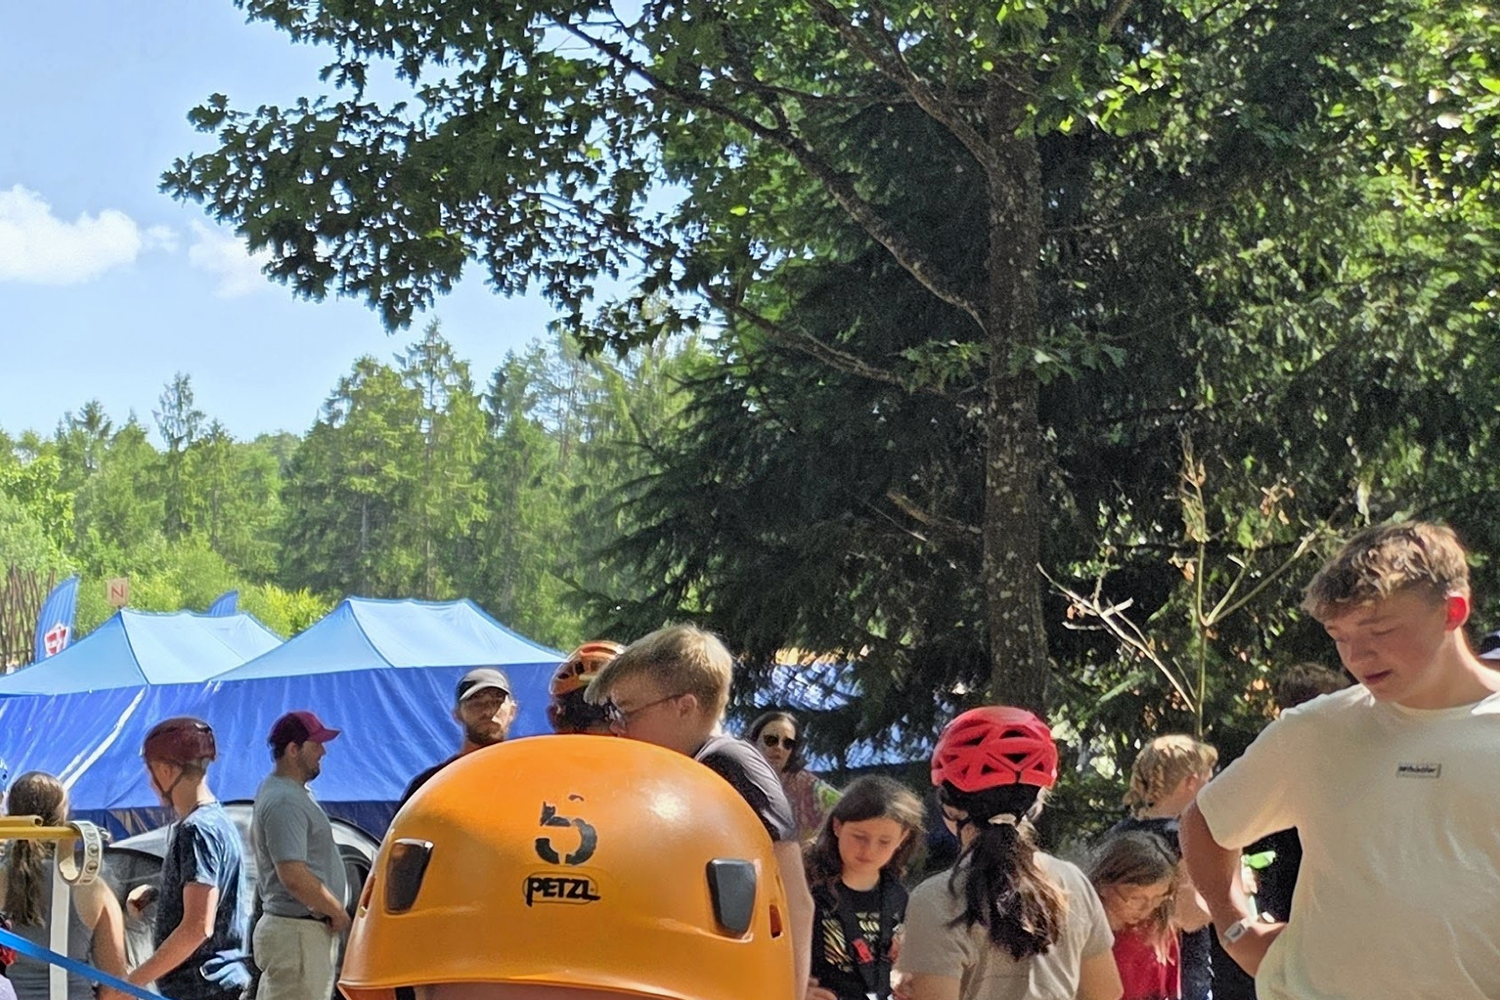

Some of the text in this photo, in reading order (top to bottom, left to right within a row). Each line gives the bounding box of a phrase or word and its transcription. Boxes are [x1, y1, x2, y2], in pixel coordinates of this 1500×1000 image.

[111, 582, 125, 600] N
[534, 794, 598, 866] 5
[526, 876, 602, 908] PETZL
